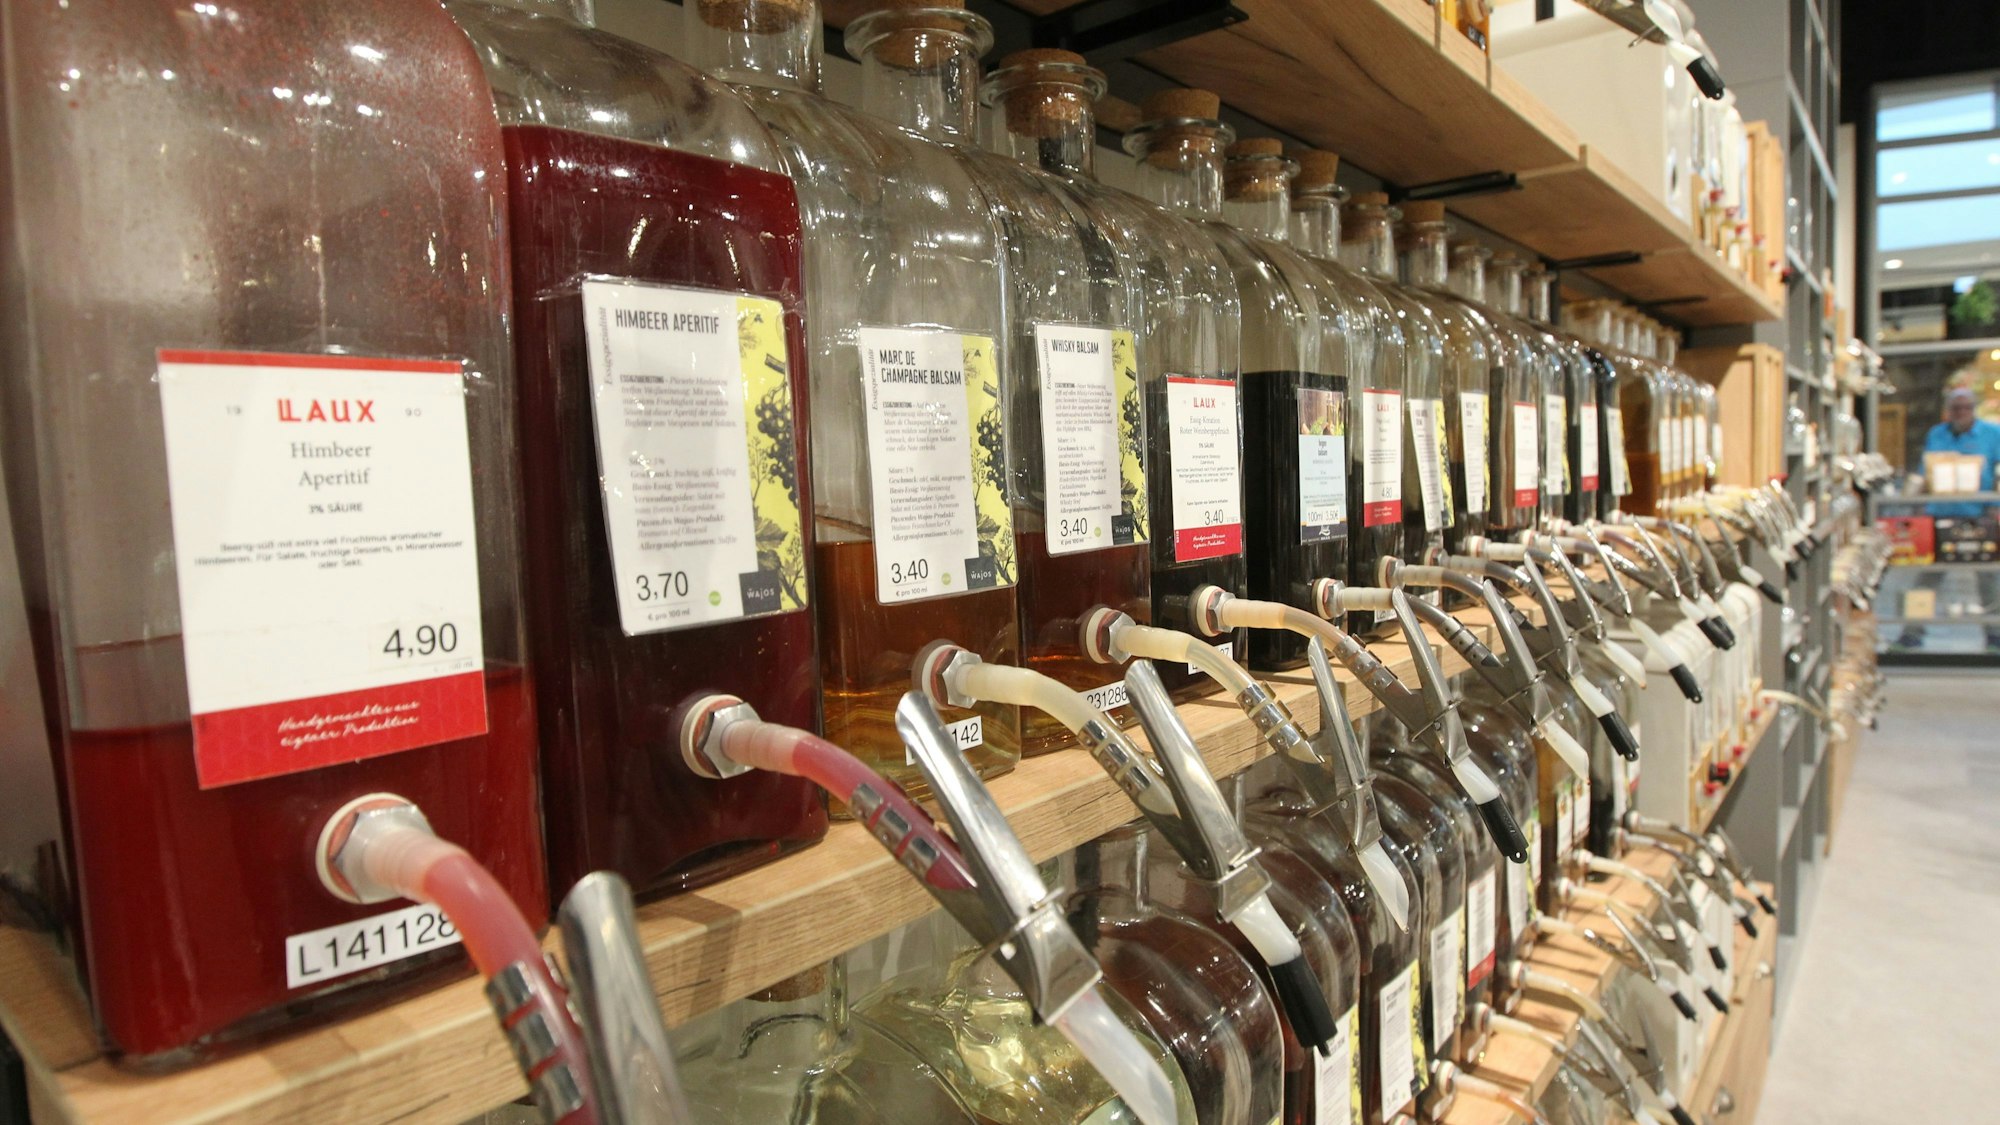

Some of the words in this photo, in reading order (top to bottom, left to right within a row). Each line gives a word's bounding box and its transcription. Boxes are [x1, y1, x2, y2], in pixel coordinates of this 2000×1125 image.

[615, 308, 669, 331] HIMBEER
[673, 313, 720, 334] APERITIF
[1051, 339, 1076, 353] WHISKY
[1076, 340, 1100, 354] BALSAM
[879, 349, 903, 365] MARC
[905, 350, 916, 366] DE
[881, 367, 929, 385] CHAMPAGNE
[930, 369, 962, 385] BALSAM
[405, 407, 423, 417] 90
[290, 441, 372, 459] Himbeer
[298, 468, 372, 491] Aperitif
[1060, 517, 1088, 537] 3,40
[1204, 509, 1224, 526] 3,40
[277, 540, 293, 549] mit
[294, 539, 320, 548] extra
[322, 536, 338, 546] viel
[340, 534, 387, 545] Fruchtmus
[389, 529, 443, 543] aromatischer
[256, 550, 272, 563] Für
[310, 546, 351, 560] fruchtige
[405, 539, 463, 552] Mineralwasser
[318, 559, 339, 570] oder
[891, 558, 929, 584] 3,40
[636, 570, 689, 602] 3,70
[900, 588, 911, 597] pro
[668, 610, 681, 618] 100
[383, 622, 458, 659] 4,90
[342, 715, 420, 737] Produktion
[299, 912, 458, 977] L141128
